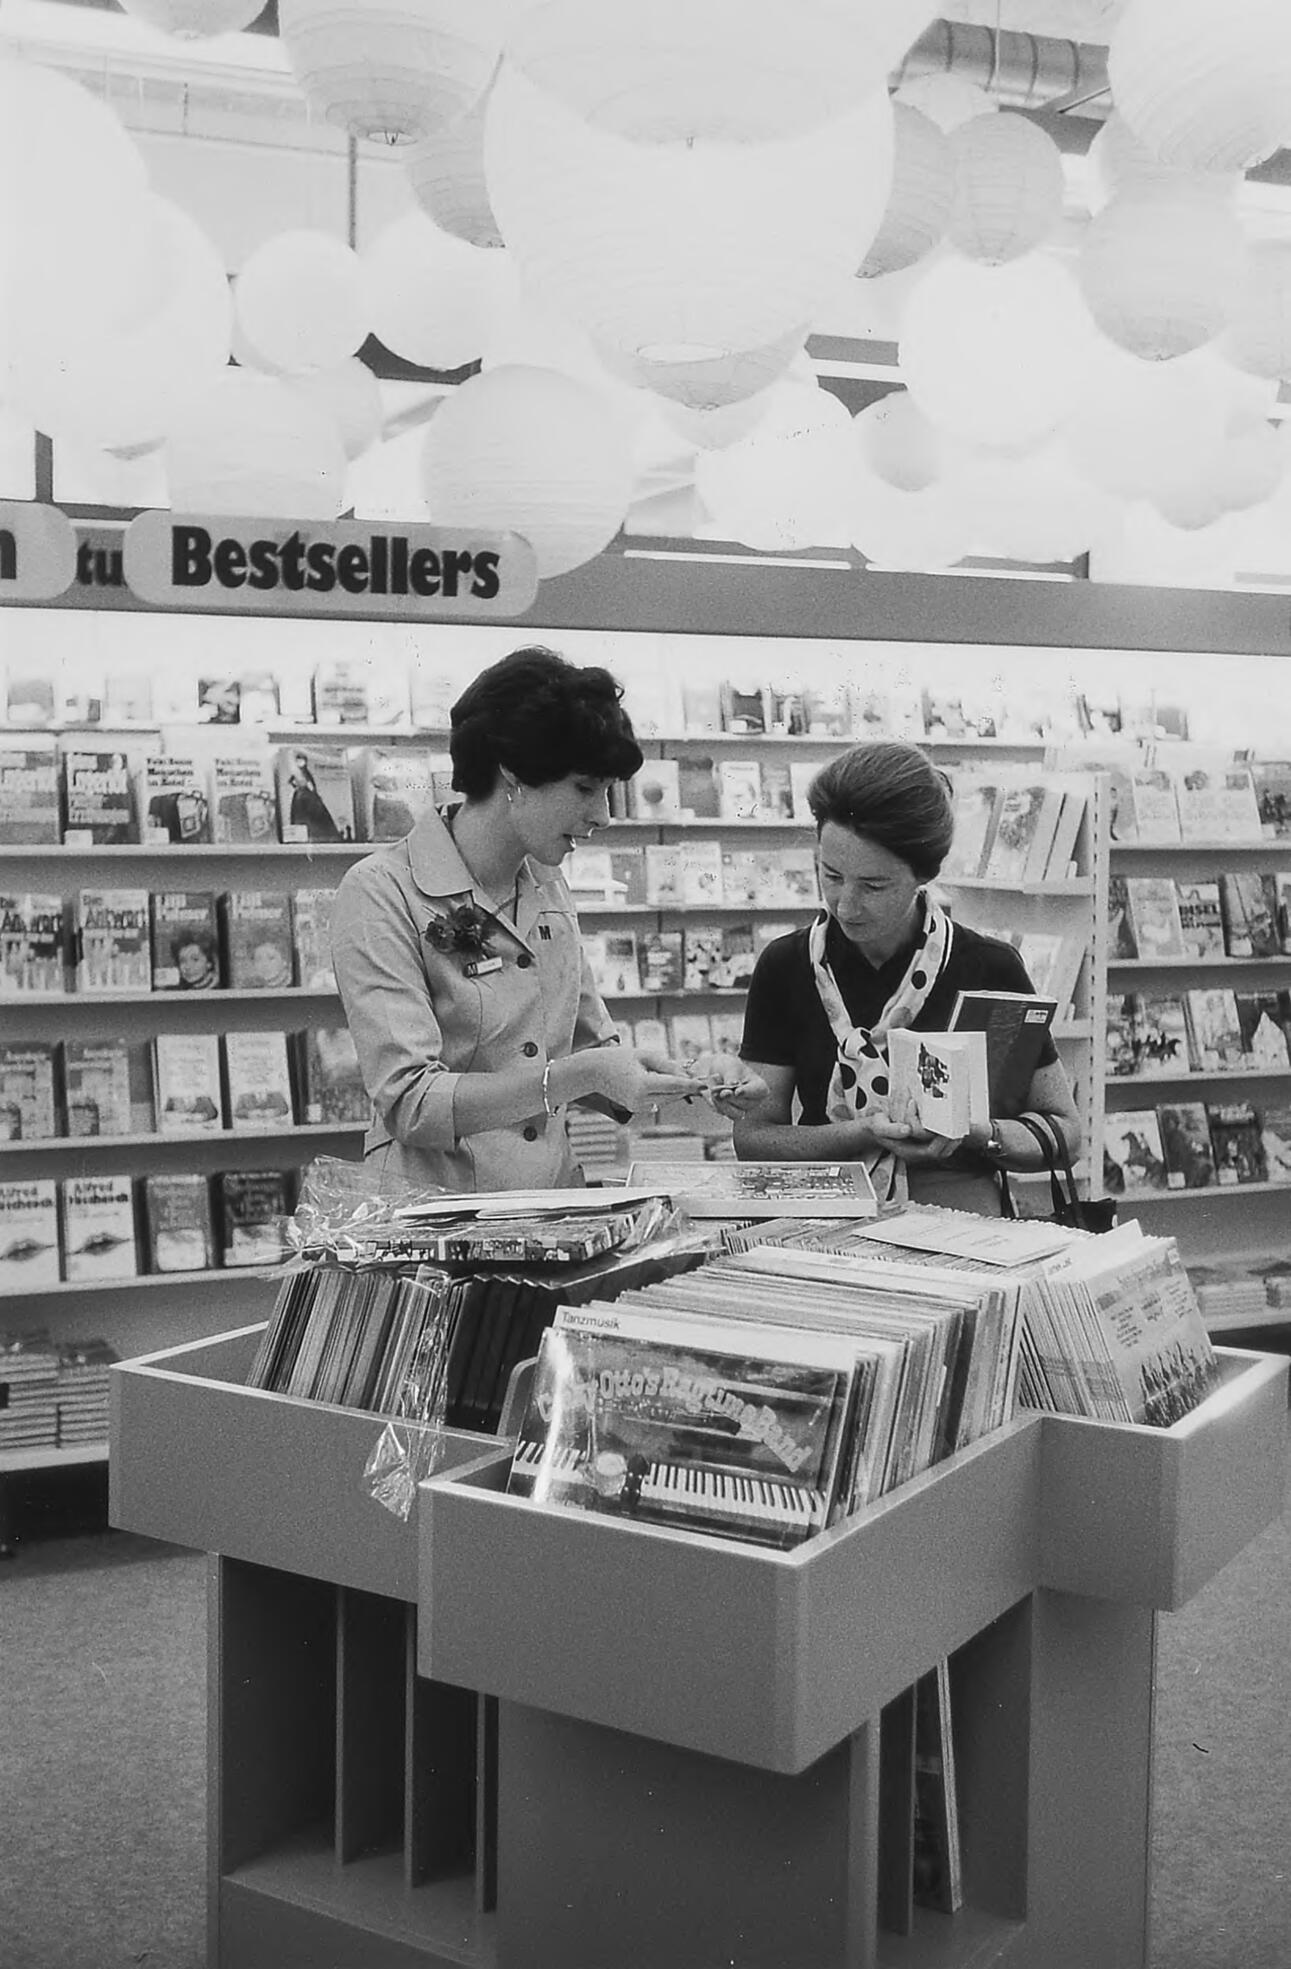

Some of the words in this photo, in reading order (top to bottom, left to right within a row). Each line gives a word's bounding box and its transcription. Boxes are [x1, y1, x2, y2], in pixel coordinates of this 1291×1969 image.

[171, 525, 500, 599] Bestsellers
[562, 1311, 621, 1331] Tanzmusik
[599, 1366, 661, 1399] Otto's
